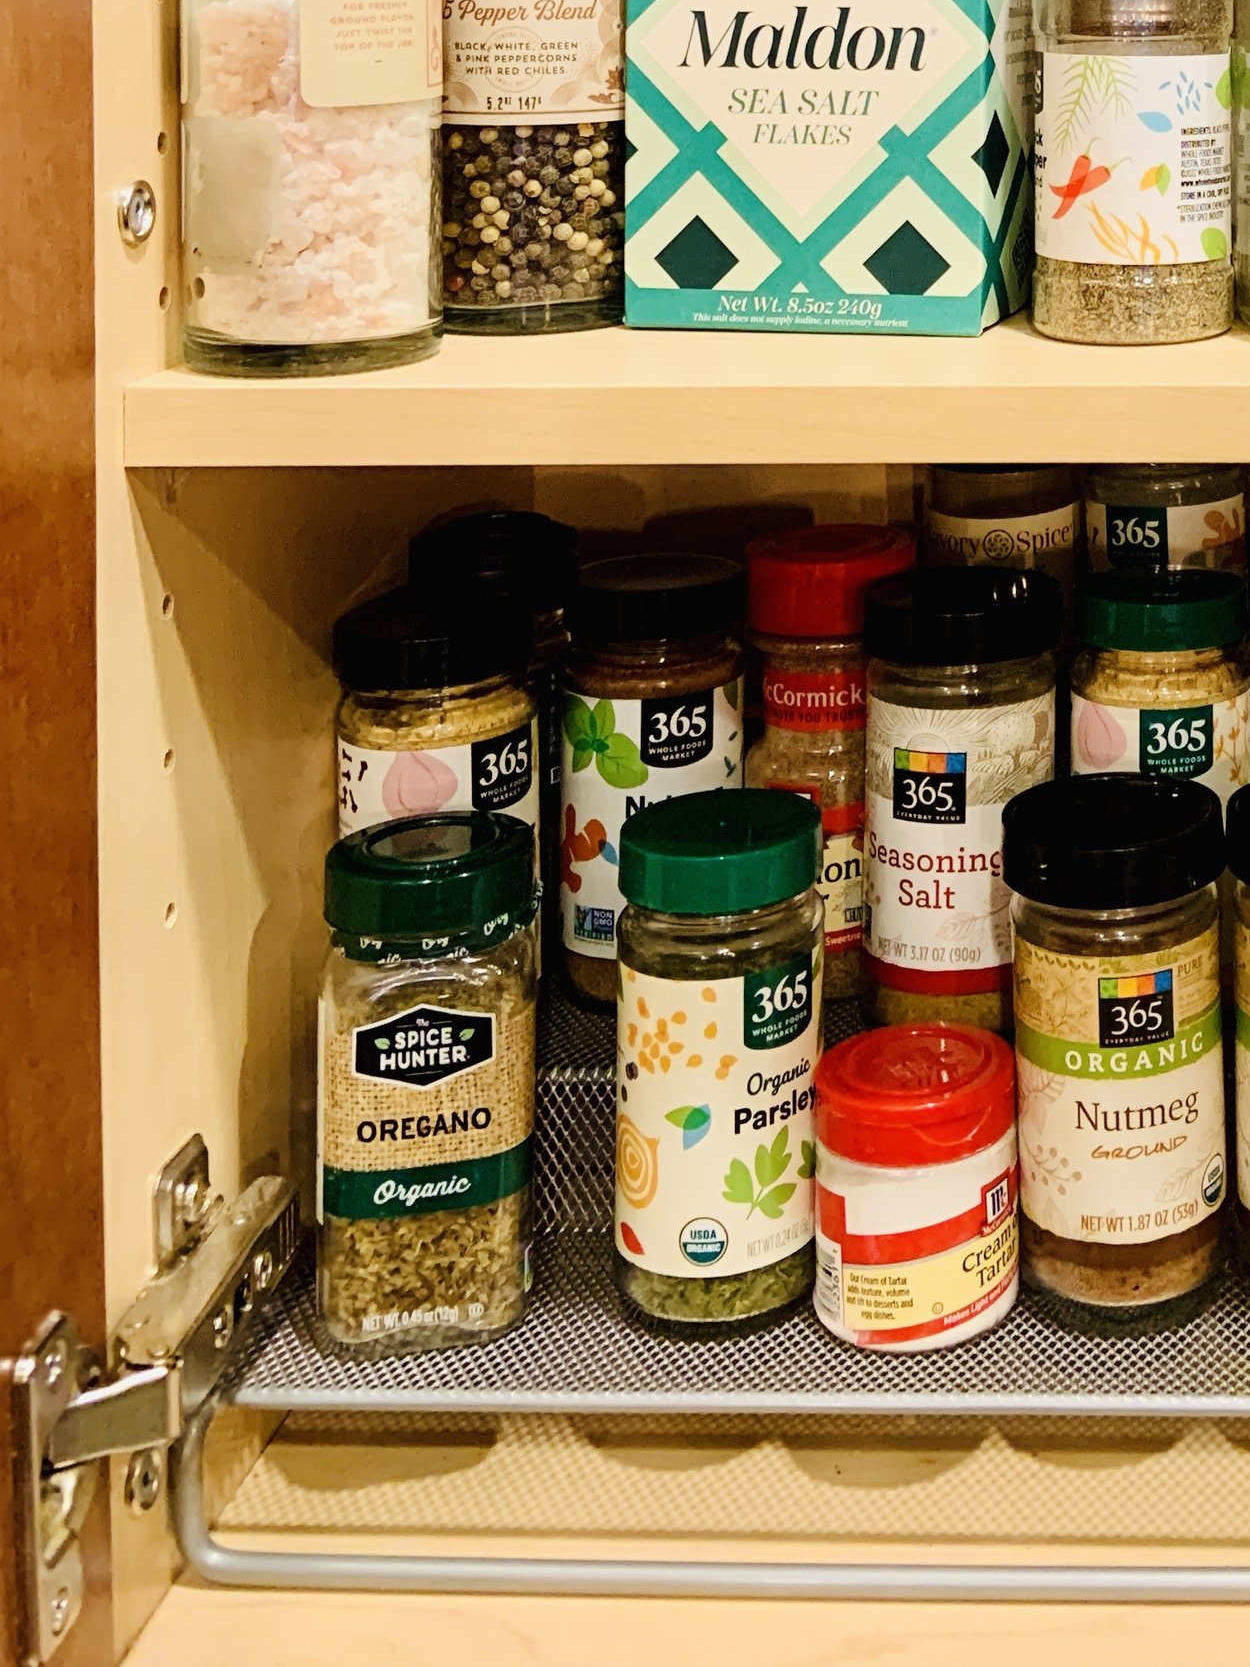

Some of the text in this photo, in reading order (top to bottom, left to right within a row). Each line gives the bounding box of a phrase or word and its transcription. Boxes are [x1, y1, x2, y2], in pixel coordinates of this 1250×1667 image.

[442, 0, 453, 20] 5
[541, 42, 578, 50] GREEN
[676, 6, 928, 72] Maldon
[456, 53, 577, 63] & PINK PEPPERCORNS
[466, 65, 565, 76] WITH RED CHILES
[728, 88, 880, 118] SEA SALT
[752, 123, 853, 146] FLAKES
[692, 313, 711, 322] This
[712, 313, 728, 322] salt
[729, 313, 749, 323] does
[750, 314, 765, 323] not
[765, 315, 793, 325] supply
[831, 316, 873, 327] necessary
[874, 319, 909, 328] nutrient
[718, 295, 883, 320] Net Wt. 8.5oz 240g
[1016, 525, 1069, 555] Spice
[1111, 517, 1160, 548] 365
[649, 705, 707, 744] 365
[1146, 717, 1206, 754] 365
[649, 740, 707, 756] WHOLE FOODS
[662, 750, 695, 762] MARKET
[1147, 755, 1206, 766] WHOLE FOODS
[479, 739, 528, 786] 365
[1160, 765, 1195, 774] MARKET
[480, 774, 529, 799] WHOLE FOODS
[492, 787, 521, 804] MARKET
[901, 776, 954, 812] 365
[869, 831, 1001, 877] Seasoning
[898, 879, 956, 910] Salt
[593, 910, 613, 919] NON
[911, 945, 981, 963] 3.17 (90g)
[1177, 955, 1203, 977] PURE
[751, 970, 808, 1024] 365
[752, 1010, 808, 1037] WHOLE FOODS
[1111, 999, 1163, 1035] 365
[394, 1027, 453, 1050] SPICE
[766, 1024, 798, 1042] MARKET
[379, 1045, 467, 1071] HUNTER
[1065, 1031, 1204, 1073] ORGANIC
[746, 1057, 812, 1097] Organic
[734, 1085, 817, 1134] Parsley
[1075, 1091, 1199, 1132] Nutmeg
[357, 1107, 492, 1143] OREGANO
[1091, 1135, 1187, 1160] GROUND
[373, 1175, 472, 1207] Organic
[1128, 1198, 1199, 1232] 1.87 (53g)
[690, 1229, 717, 1240] USDA
[962, 1225, 1012, 1274] Cream
[975, 1239, 1016, 1288] Tartar
[886, 1287, 910, 1297] volume
[888, 1275, 907, 1285] Tartar
[873, 1298, 913, 1308] desserts and
[944, 1297, 989, 1326] Makes Light
